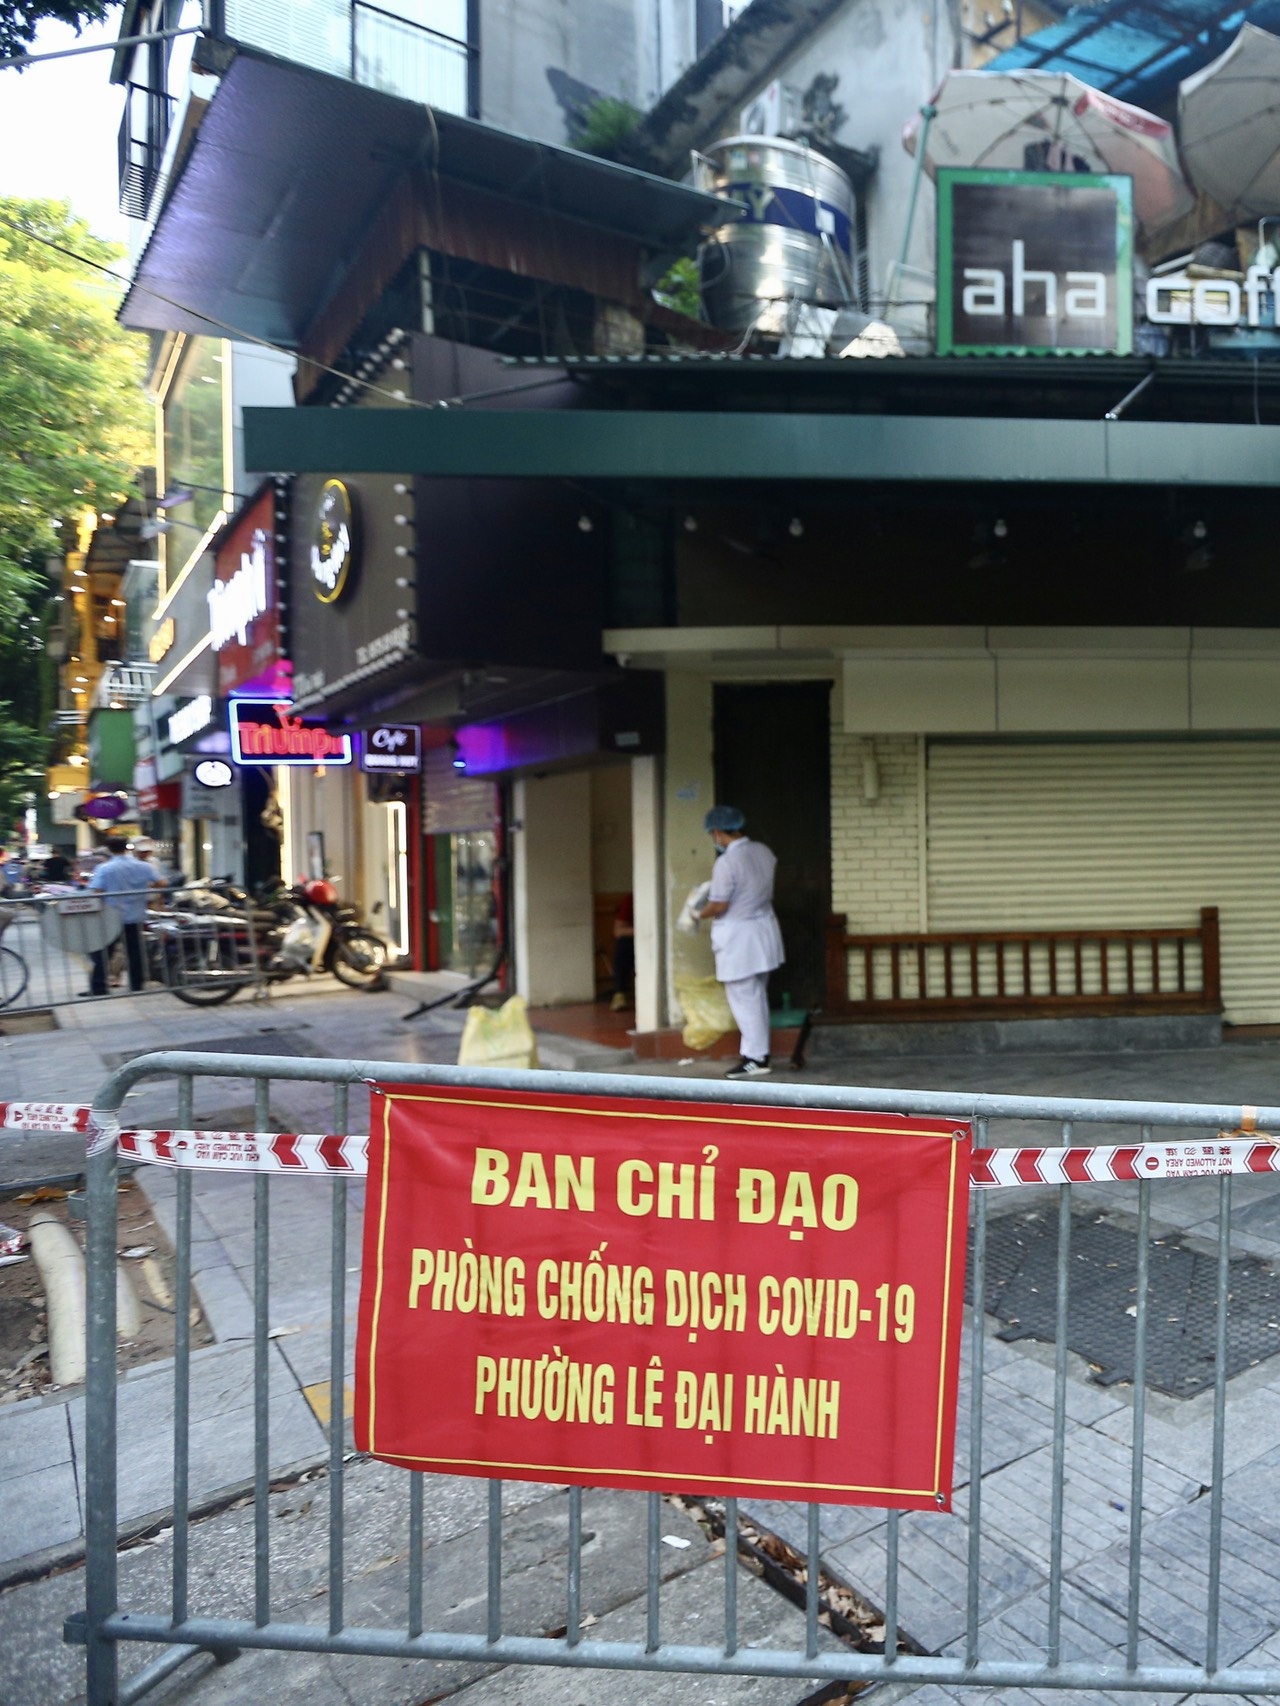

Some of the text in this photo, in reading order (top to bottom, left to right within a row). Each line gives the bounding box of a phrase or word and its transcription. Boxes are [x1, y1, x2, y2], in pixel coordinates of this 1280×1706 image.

[962, 240, 1107, 318] aha
[473, 1146, 858, 1239] BAN CHỈ ĐẠO
[1165, 1157, 1232, 1168] NOT ALLOWED AREA
[410, 1239, 914, 1342] PHÒNG CHỐNG DỊCH COVID-19
[477, 1347, 839, 1443] PHƯỜNG LÊ ĐẠI HÀNH
